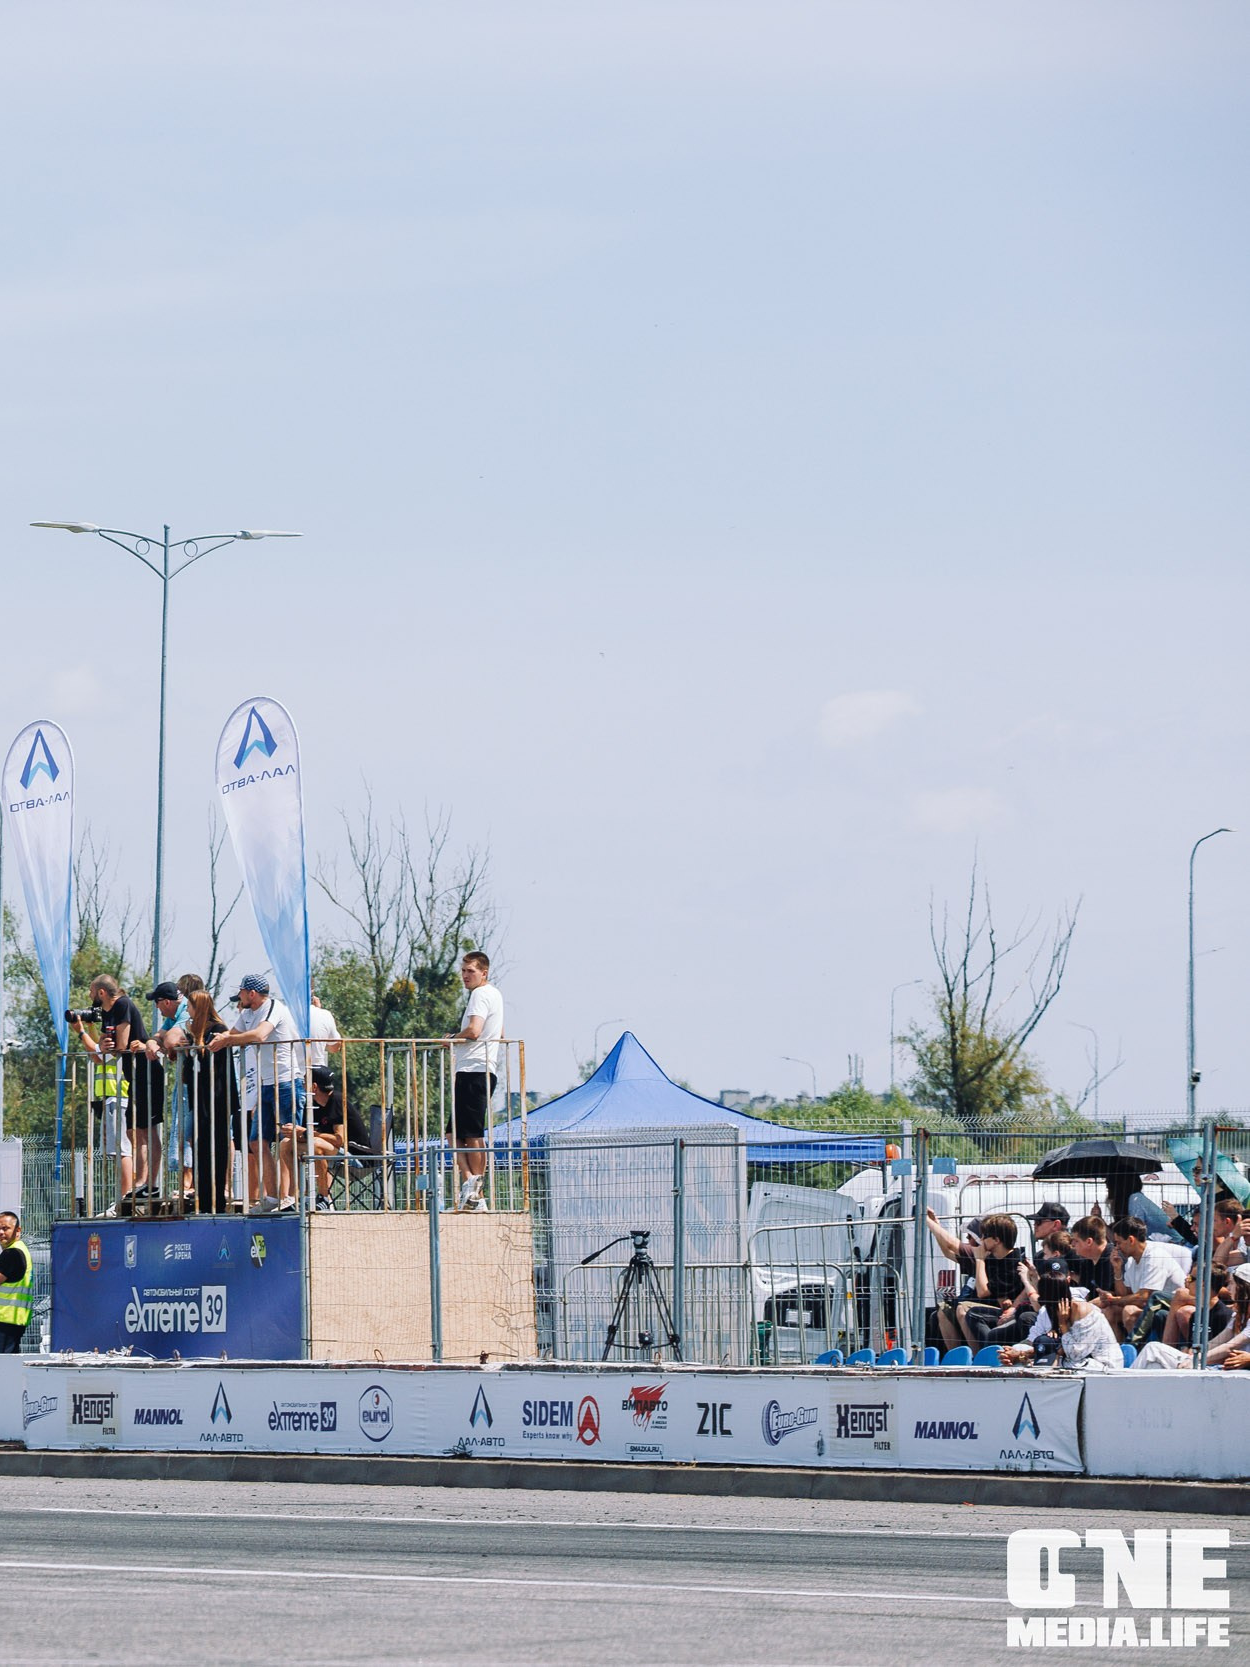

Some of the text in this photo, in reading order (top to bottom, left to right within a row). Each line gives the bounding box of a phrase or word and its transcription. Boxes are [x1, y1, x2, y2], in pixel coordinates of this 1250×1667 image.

[174, 1243, 192, 1251] РОСТЕХ
[174, 1251, 192, 1260] АРЕНА
[143, 1287, 200, 1297] АВТОМОБИЛЬНЫЙ СПОРТ
[204, 1294, 224, 1327] 39
[72, 1392, 116, 1425] Hengst
[362, 1406, 391, 1425] eurol
[522, 1400, 574, 1427] SIDEM
[621, 1400, 668, 1412] ВМПАВТО
[134, 1408, 184, 1425] MANNOL
[322, 1406, 336, 1429] 39
[695, 1402, 733, 1437] ZIC
[836, 1402, 890, 1439] Hengst
[522, 1431, 574, 1441] Experts know why
[914, 1420, 979, 1440] MANNOL
[873, 1441, 891, 1451] FILTER
